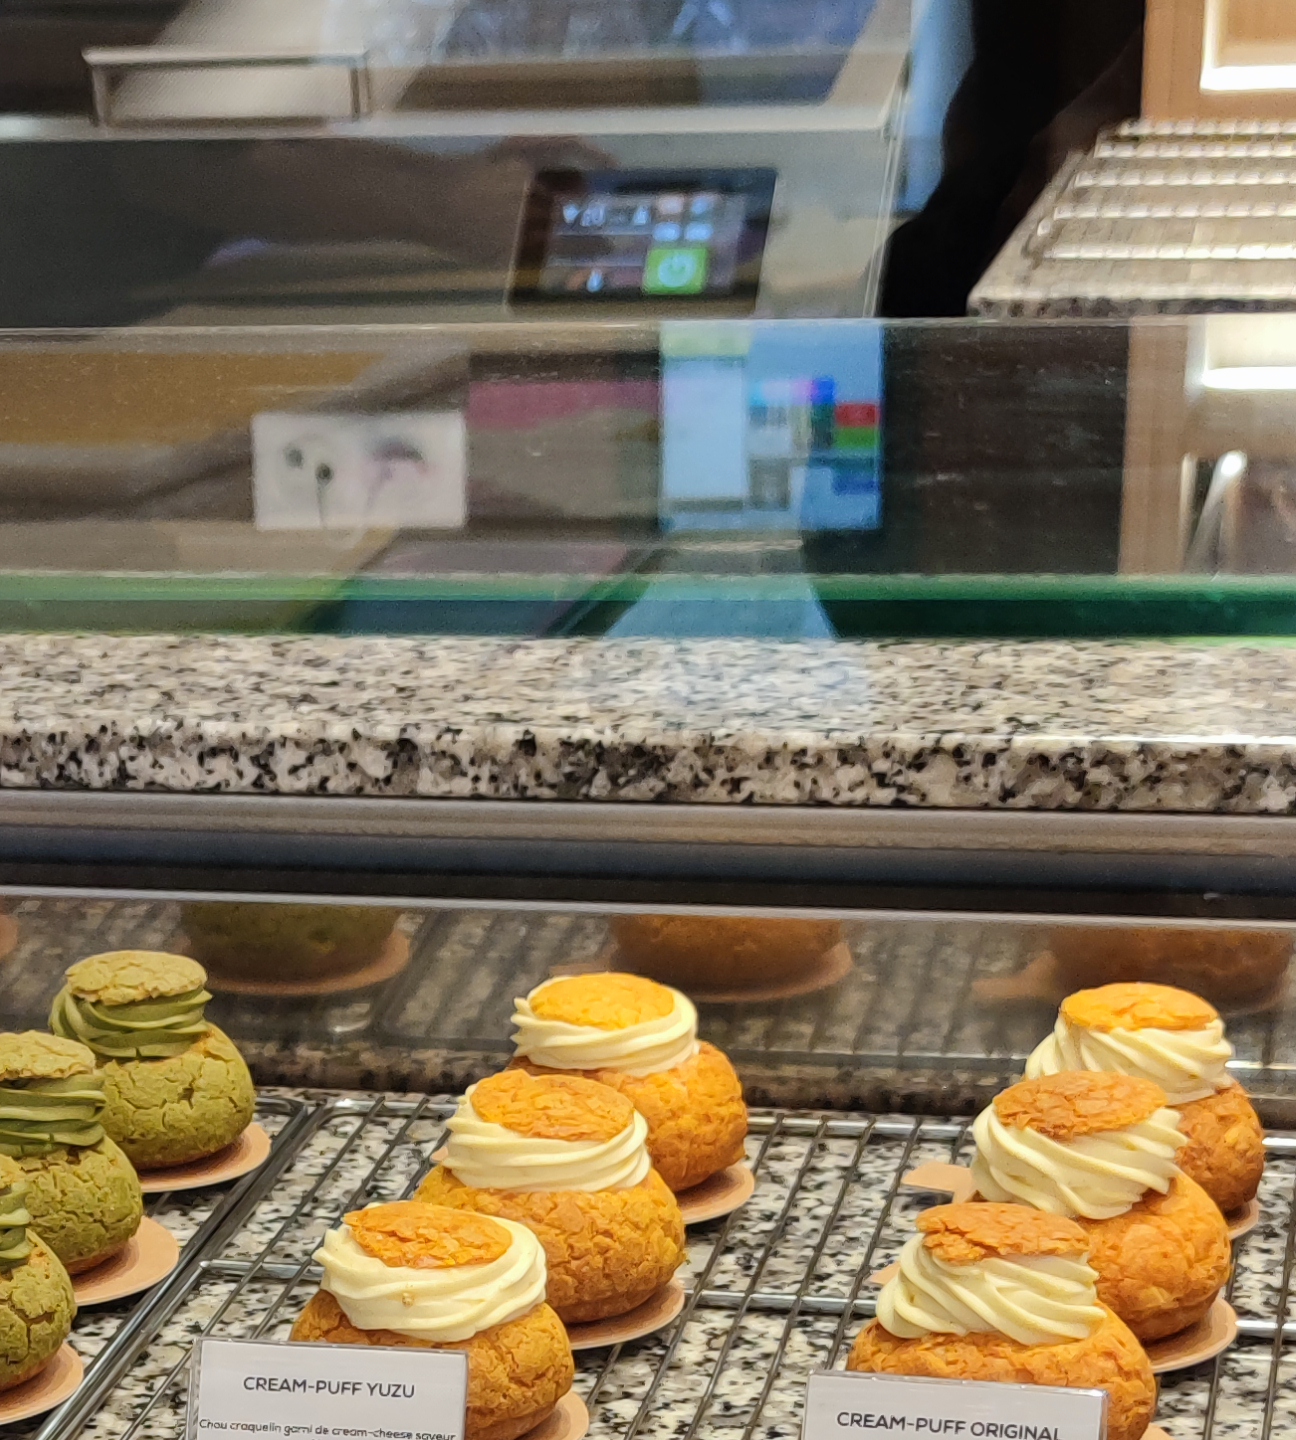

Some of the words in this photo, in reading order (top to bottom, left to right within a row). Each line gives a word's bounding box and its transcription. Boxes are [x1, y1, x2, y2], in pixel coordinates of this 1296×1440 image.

[244, 1377, 362, 1395] CREAM-PUFF
[367, 1383, 414, 1398] YUZU
[199, 1418, 228, 1430] Chou
[230, 1423, 281, 1433] craquelin
[284, 1425, 312, 1436] garni
[315, 1426, 329, 1435] de
[332, 1428, 412, 1439] cream-cheese
[416, 1433, 455, 1440] saveur
[837, 1412, 966, 1434] CREAM-PUFF
